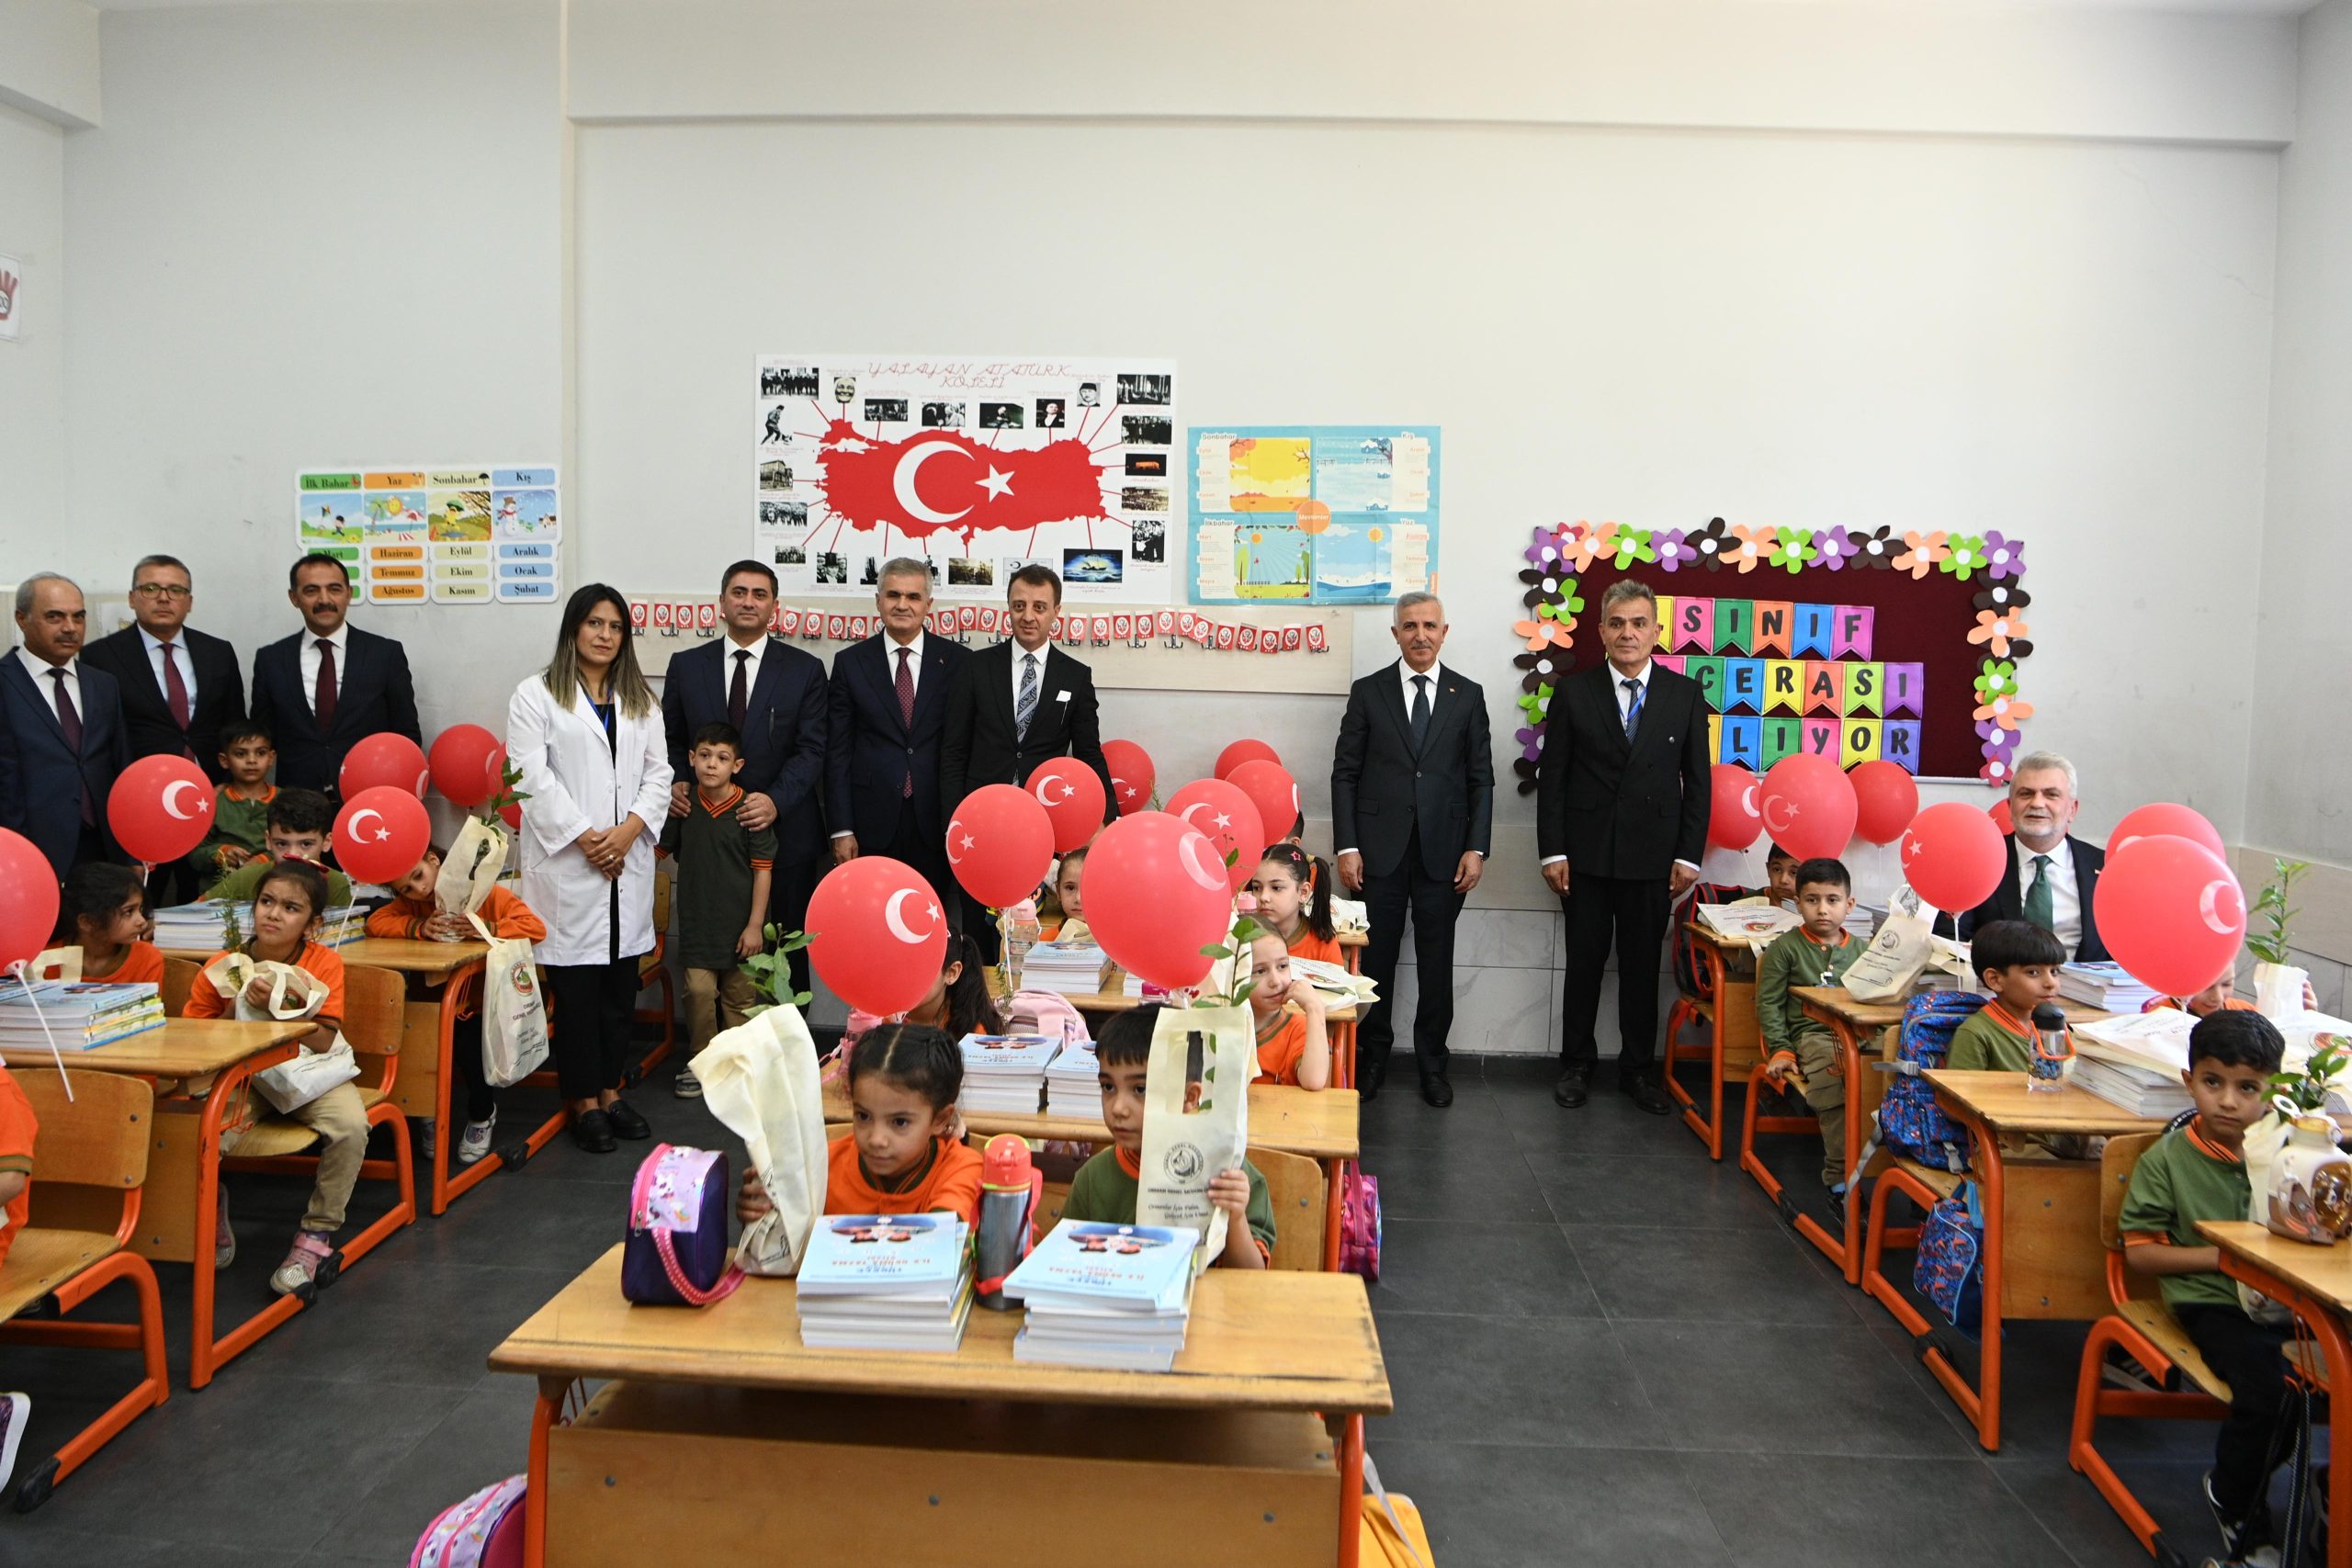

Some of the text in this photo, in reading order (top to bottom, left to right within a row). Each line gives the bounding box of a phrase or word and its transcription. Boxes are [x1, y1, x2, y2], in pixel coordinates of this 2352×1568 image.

[387, 476, 402, 486] Yaz
[433, 474, 478, 485] Sonbahar
[516, 471, 531, 483] Kış
[322, 478, 349, 489] Bahar
[379, 549, 413, 558] Haziran
[450, 546, 472, 558] Eylül
[514, 546, 539, 556] Aralık
[380, 568, 415, 577] Temmuz
[450, 567, 473, 576] Ekim
[514, 566, 537, 575] Ocak
[382, 586, 414, 596] Ağustos
[448, 586, 475, 595] Kasım
[514, 584, 538, 595] Şubat
[1682, 604, 1861, 643] SINIF
[1659, 664, 1907, 699] CERASI
[1708, 722, 1910, 755] LIYOR
